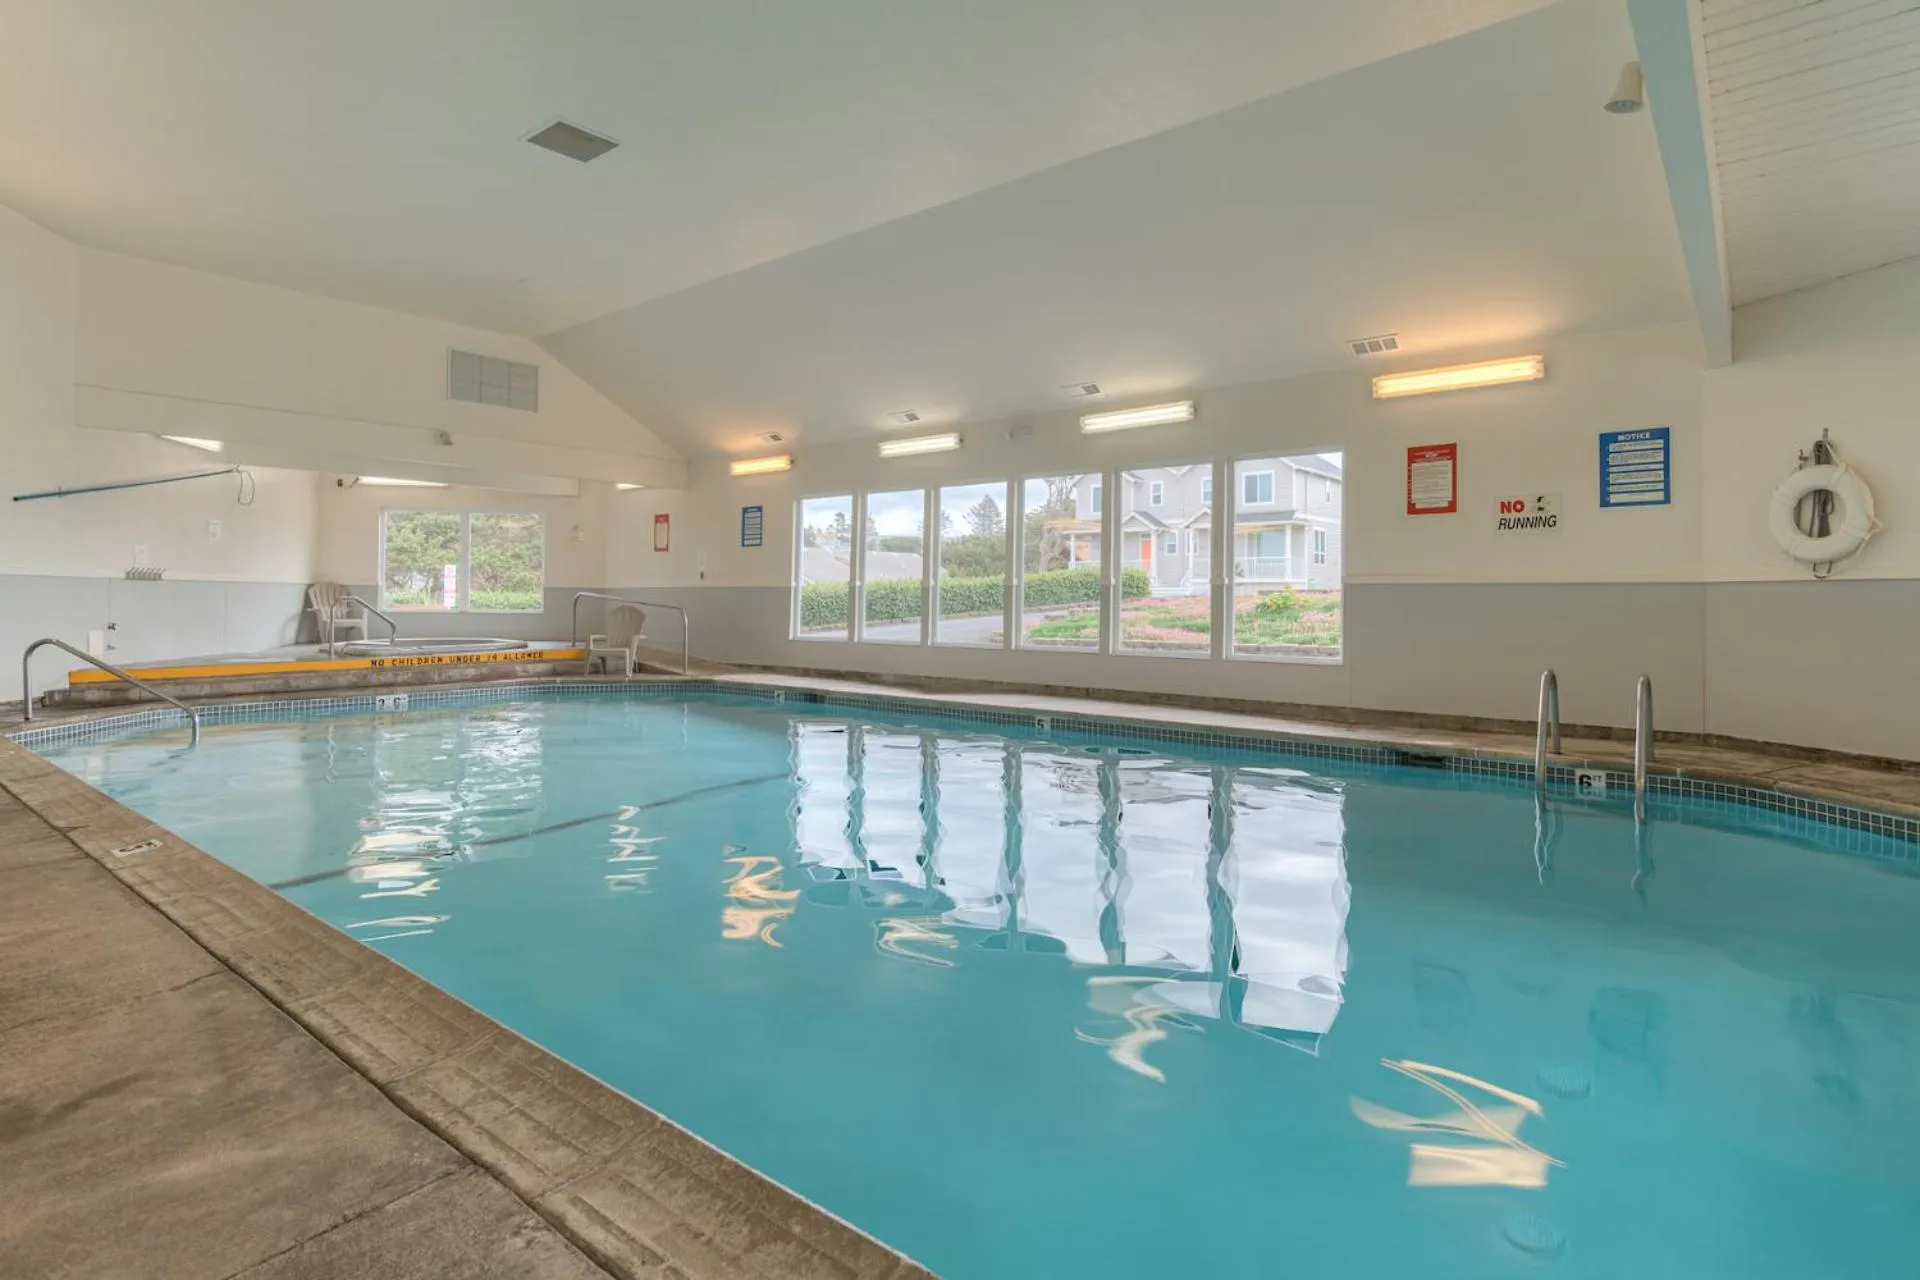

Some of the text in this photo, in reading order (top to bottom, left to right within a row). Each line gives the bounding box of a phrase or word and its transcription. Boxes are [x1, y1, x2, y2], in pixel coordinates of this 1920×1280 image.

[1617, 431, 1651, 441] NOTICE
[1499, 499, 1525, 514] NO
[1498, 514, 1557, 530] RUNNING
[370, 659, 385, 667] NO
[391, 656, 443, 667] CHILDREN
[450, 654, 481, 664] UNDER
